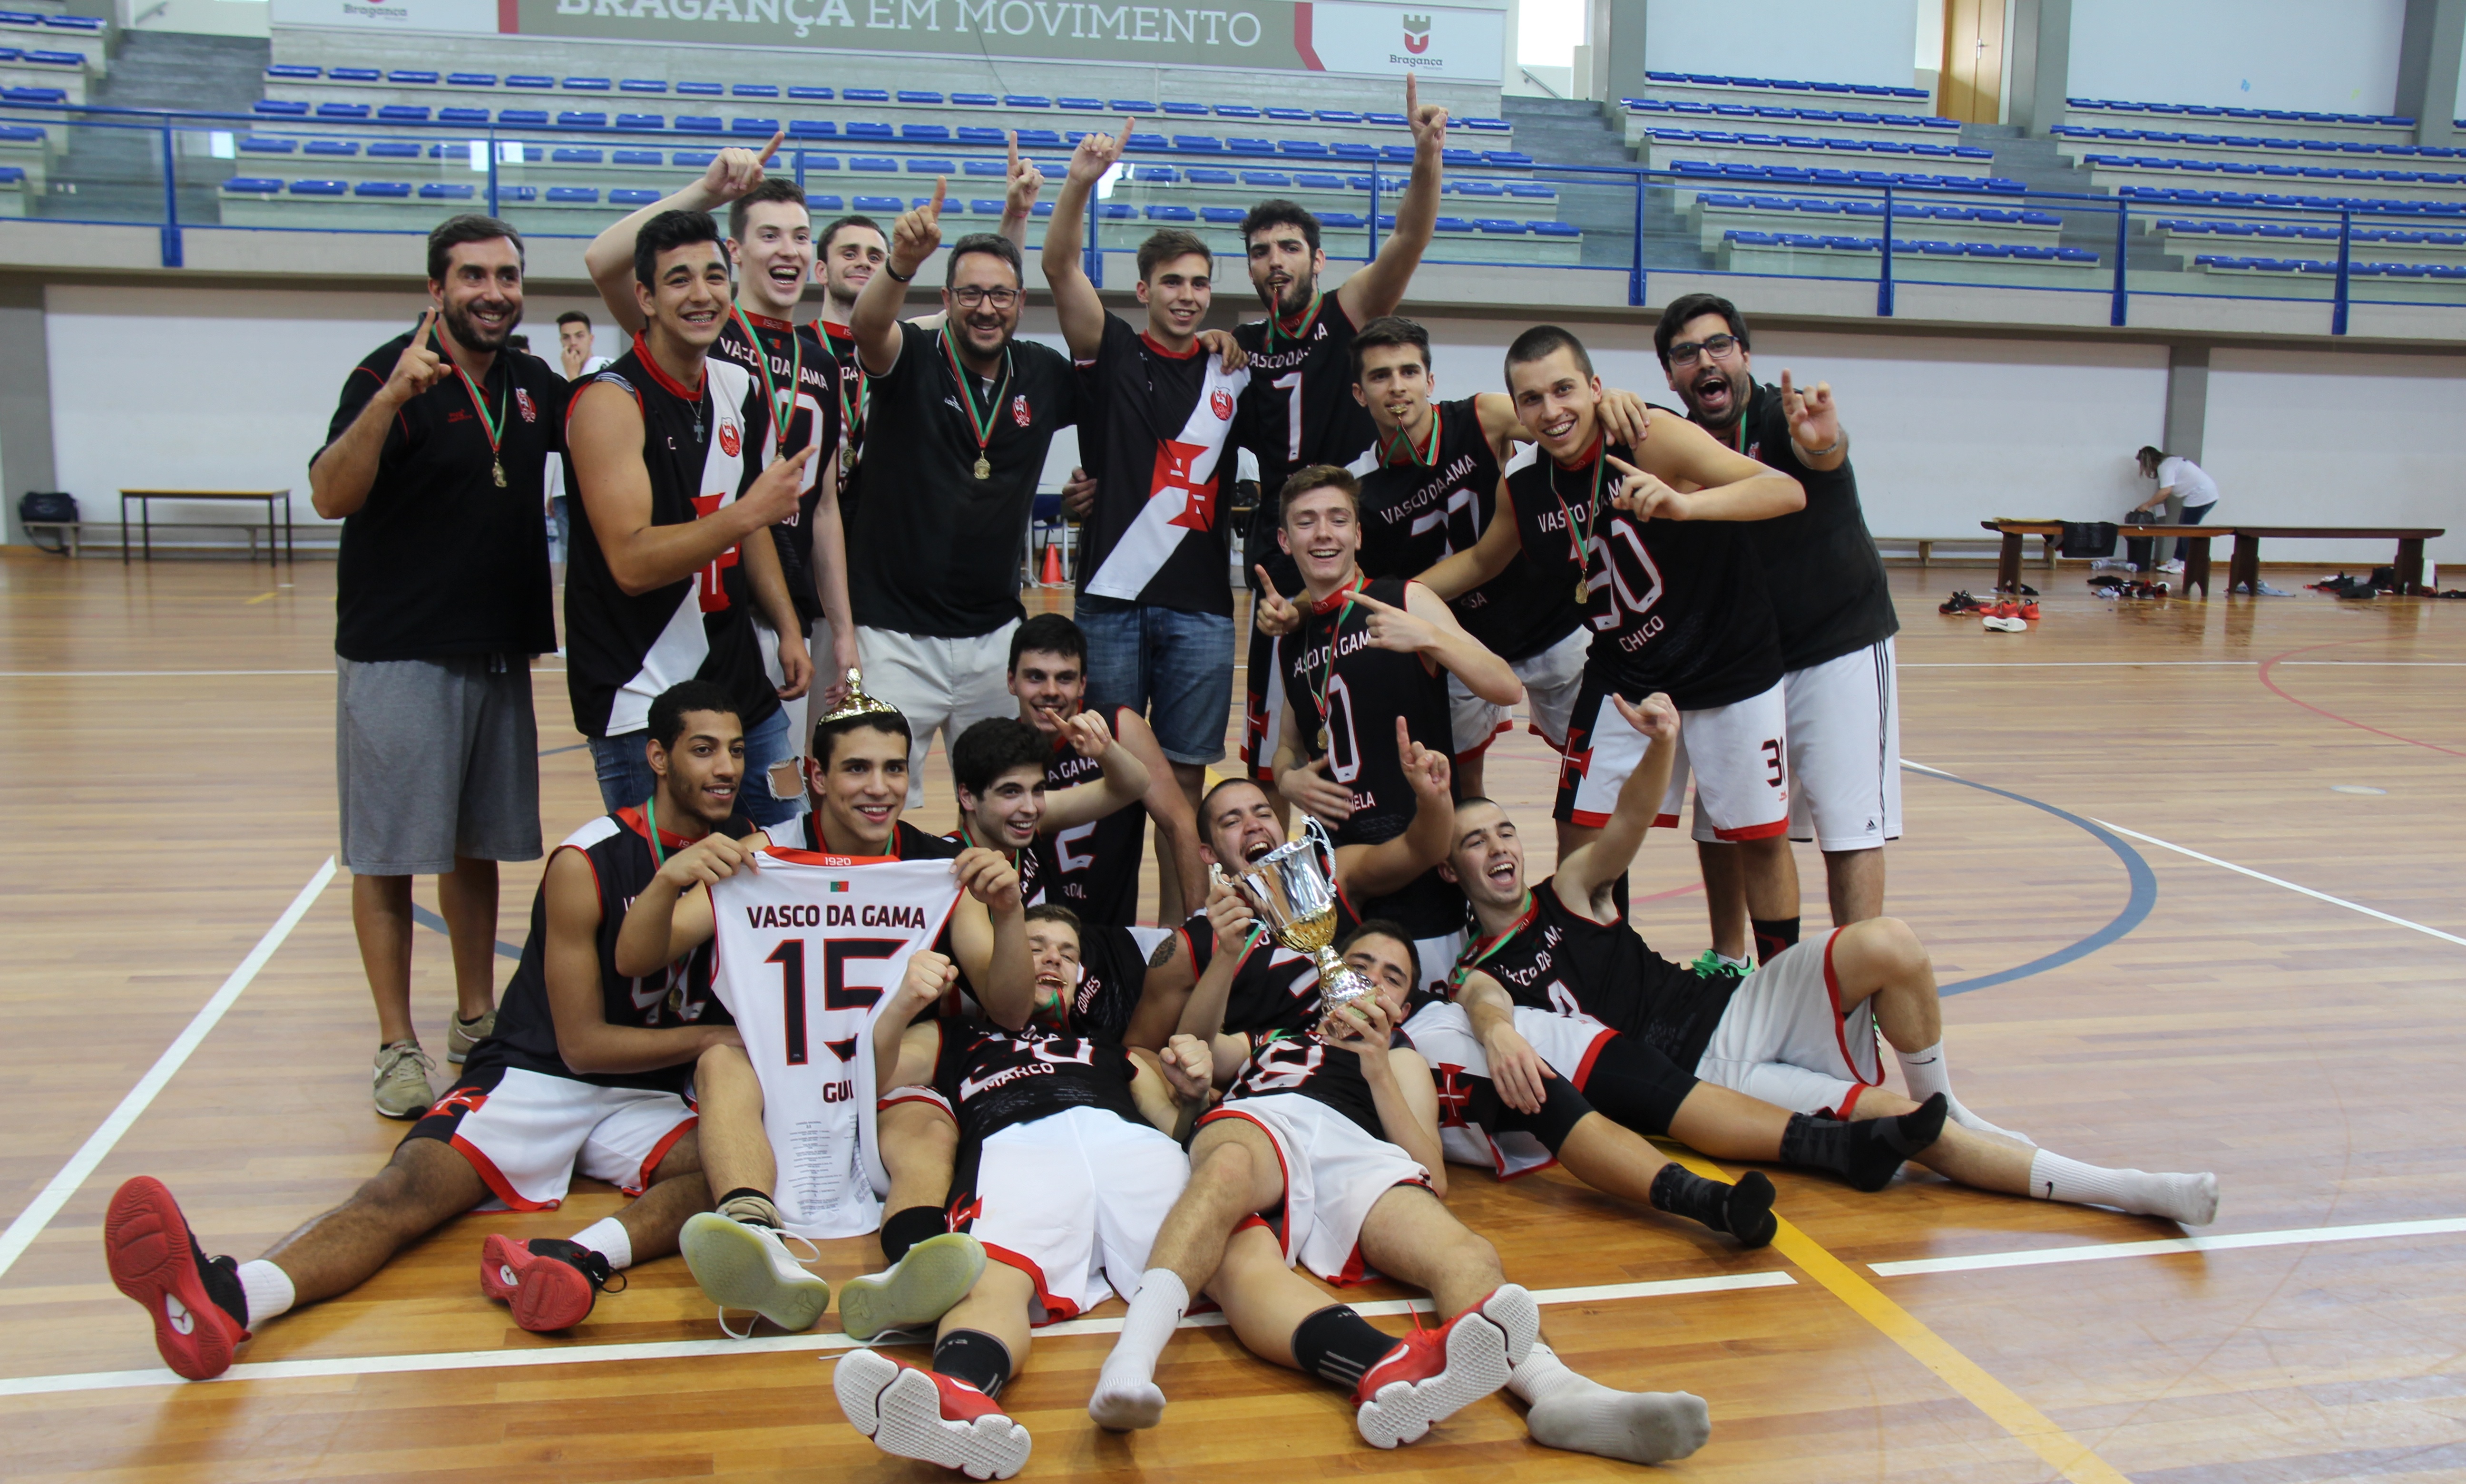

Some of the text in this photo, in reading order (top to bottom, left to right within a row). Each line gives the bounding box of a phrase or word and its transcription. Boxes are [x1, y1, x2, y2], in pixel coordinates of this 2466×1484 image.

[866, 0, 940, 31] EM
[955, 0, 1262, 47] MOVIMENTO
[771, 356, 792, 378] DA
[799, 366, 829, 391] AMA
[1248, 351, 1284, 369] ASCO
[1380, 454, 1477, 524] VASCO DA AMA
[1568, 517, 1664, 631] 30
[1340, 629, 1372, 655] GAM
[1619, 615, 1664, 652] CHICO
[1761, 736, 1786, 788] 3
[825, 857, 851, 866] 1920
[747, 905, 926, 930] VASCO DA GAMA
[764, 938, 910, 1066] 15
[1078, 975, 1101, 1014] GOMES
